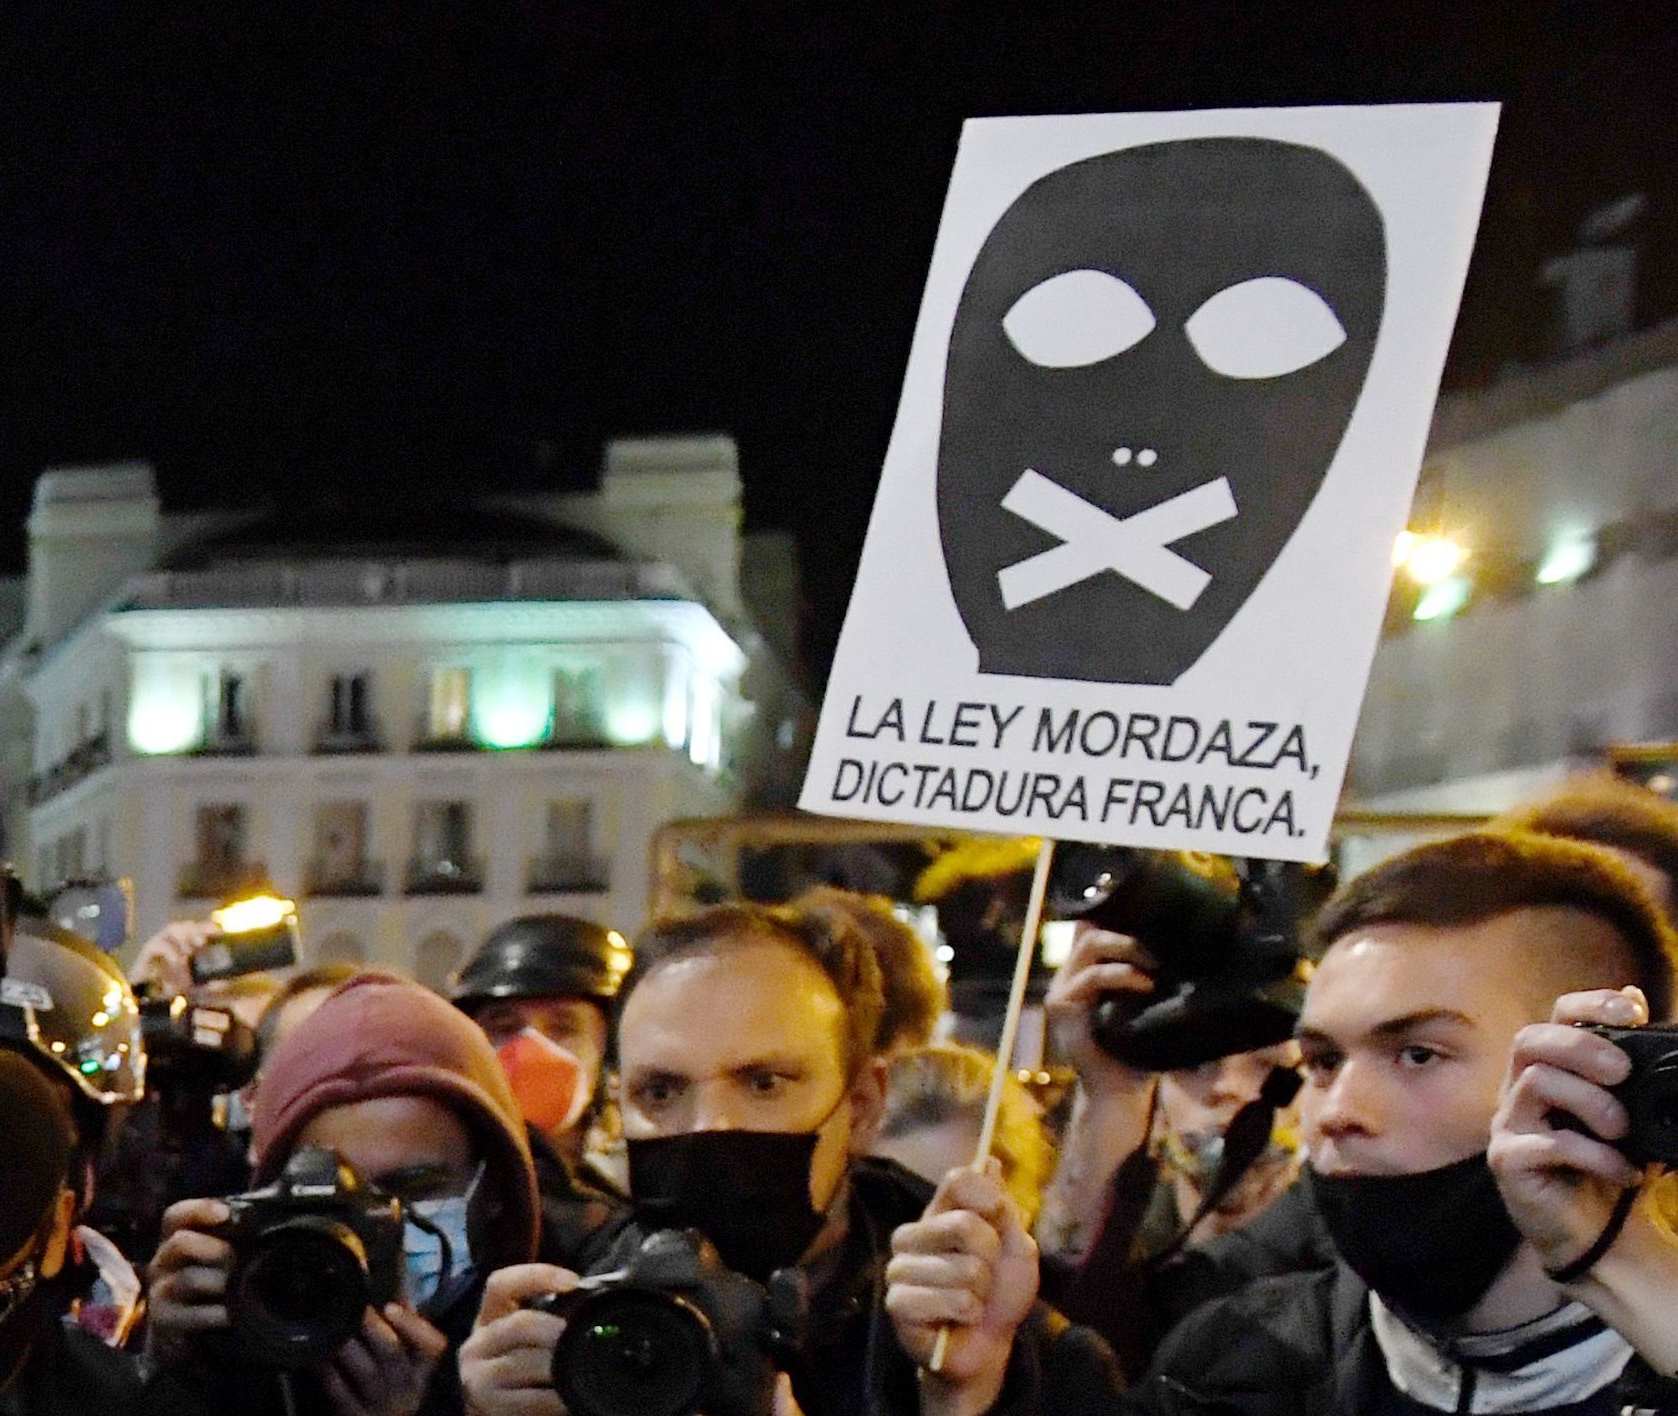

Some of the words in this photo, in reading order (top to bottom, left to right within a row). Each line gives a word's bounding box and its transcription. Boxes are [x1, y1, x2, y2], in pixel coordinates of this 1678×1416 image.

[846, 694, 905, 742] LA
[920, 699, 1025, 748] LEY
[1032, 706, 1323, 781] MORDAZA,
[831, 758, 1088, 822] DICTADURA
[1100, 777, 1307, 838] FRANCA.
